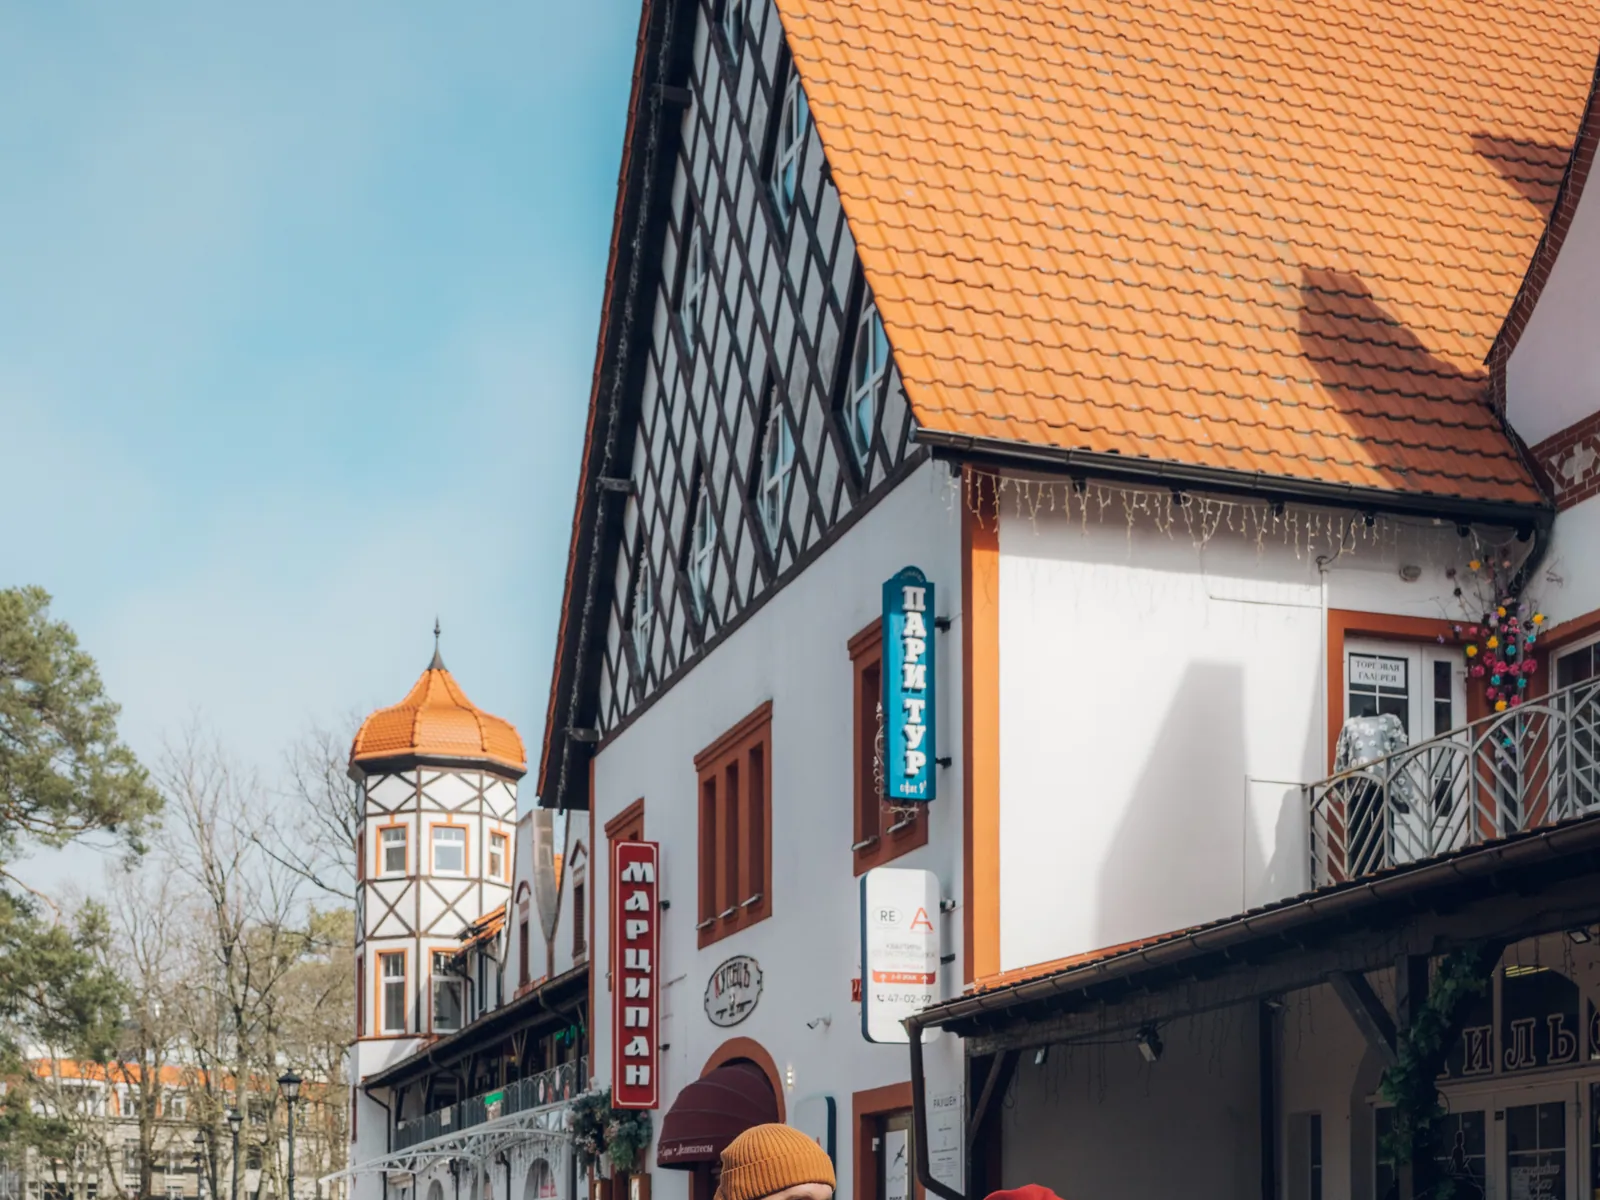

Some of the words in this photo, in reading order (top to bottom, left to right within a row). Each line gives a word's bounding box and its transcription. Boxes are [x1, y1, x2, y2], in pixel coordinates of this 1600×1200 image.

[902, 585, 927, 690] ПАРИ
[903, 698, 927, 776] ТУР
[880, 910, 896, 922] RE
[621, 861, 655, 1086] МАРЦИПАН
